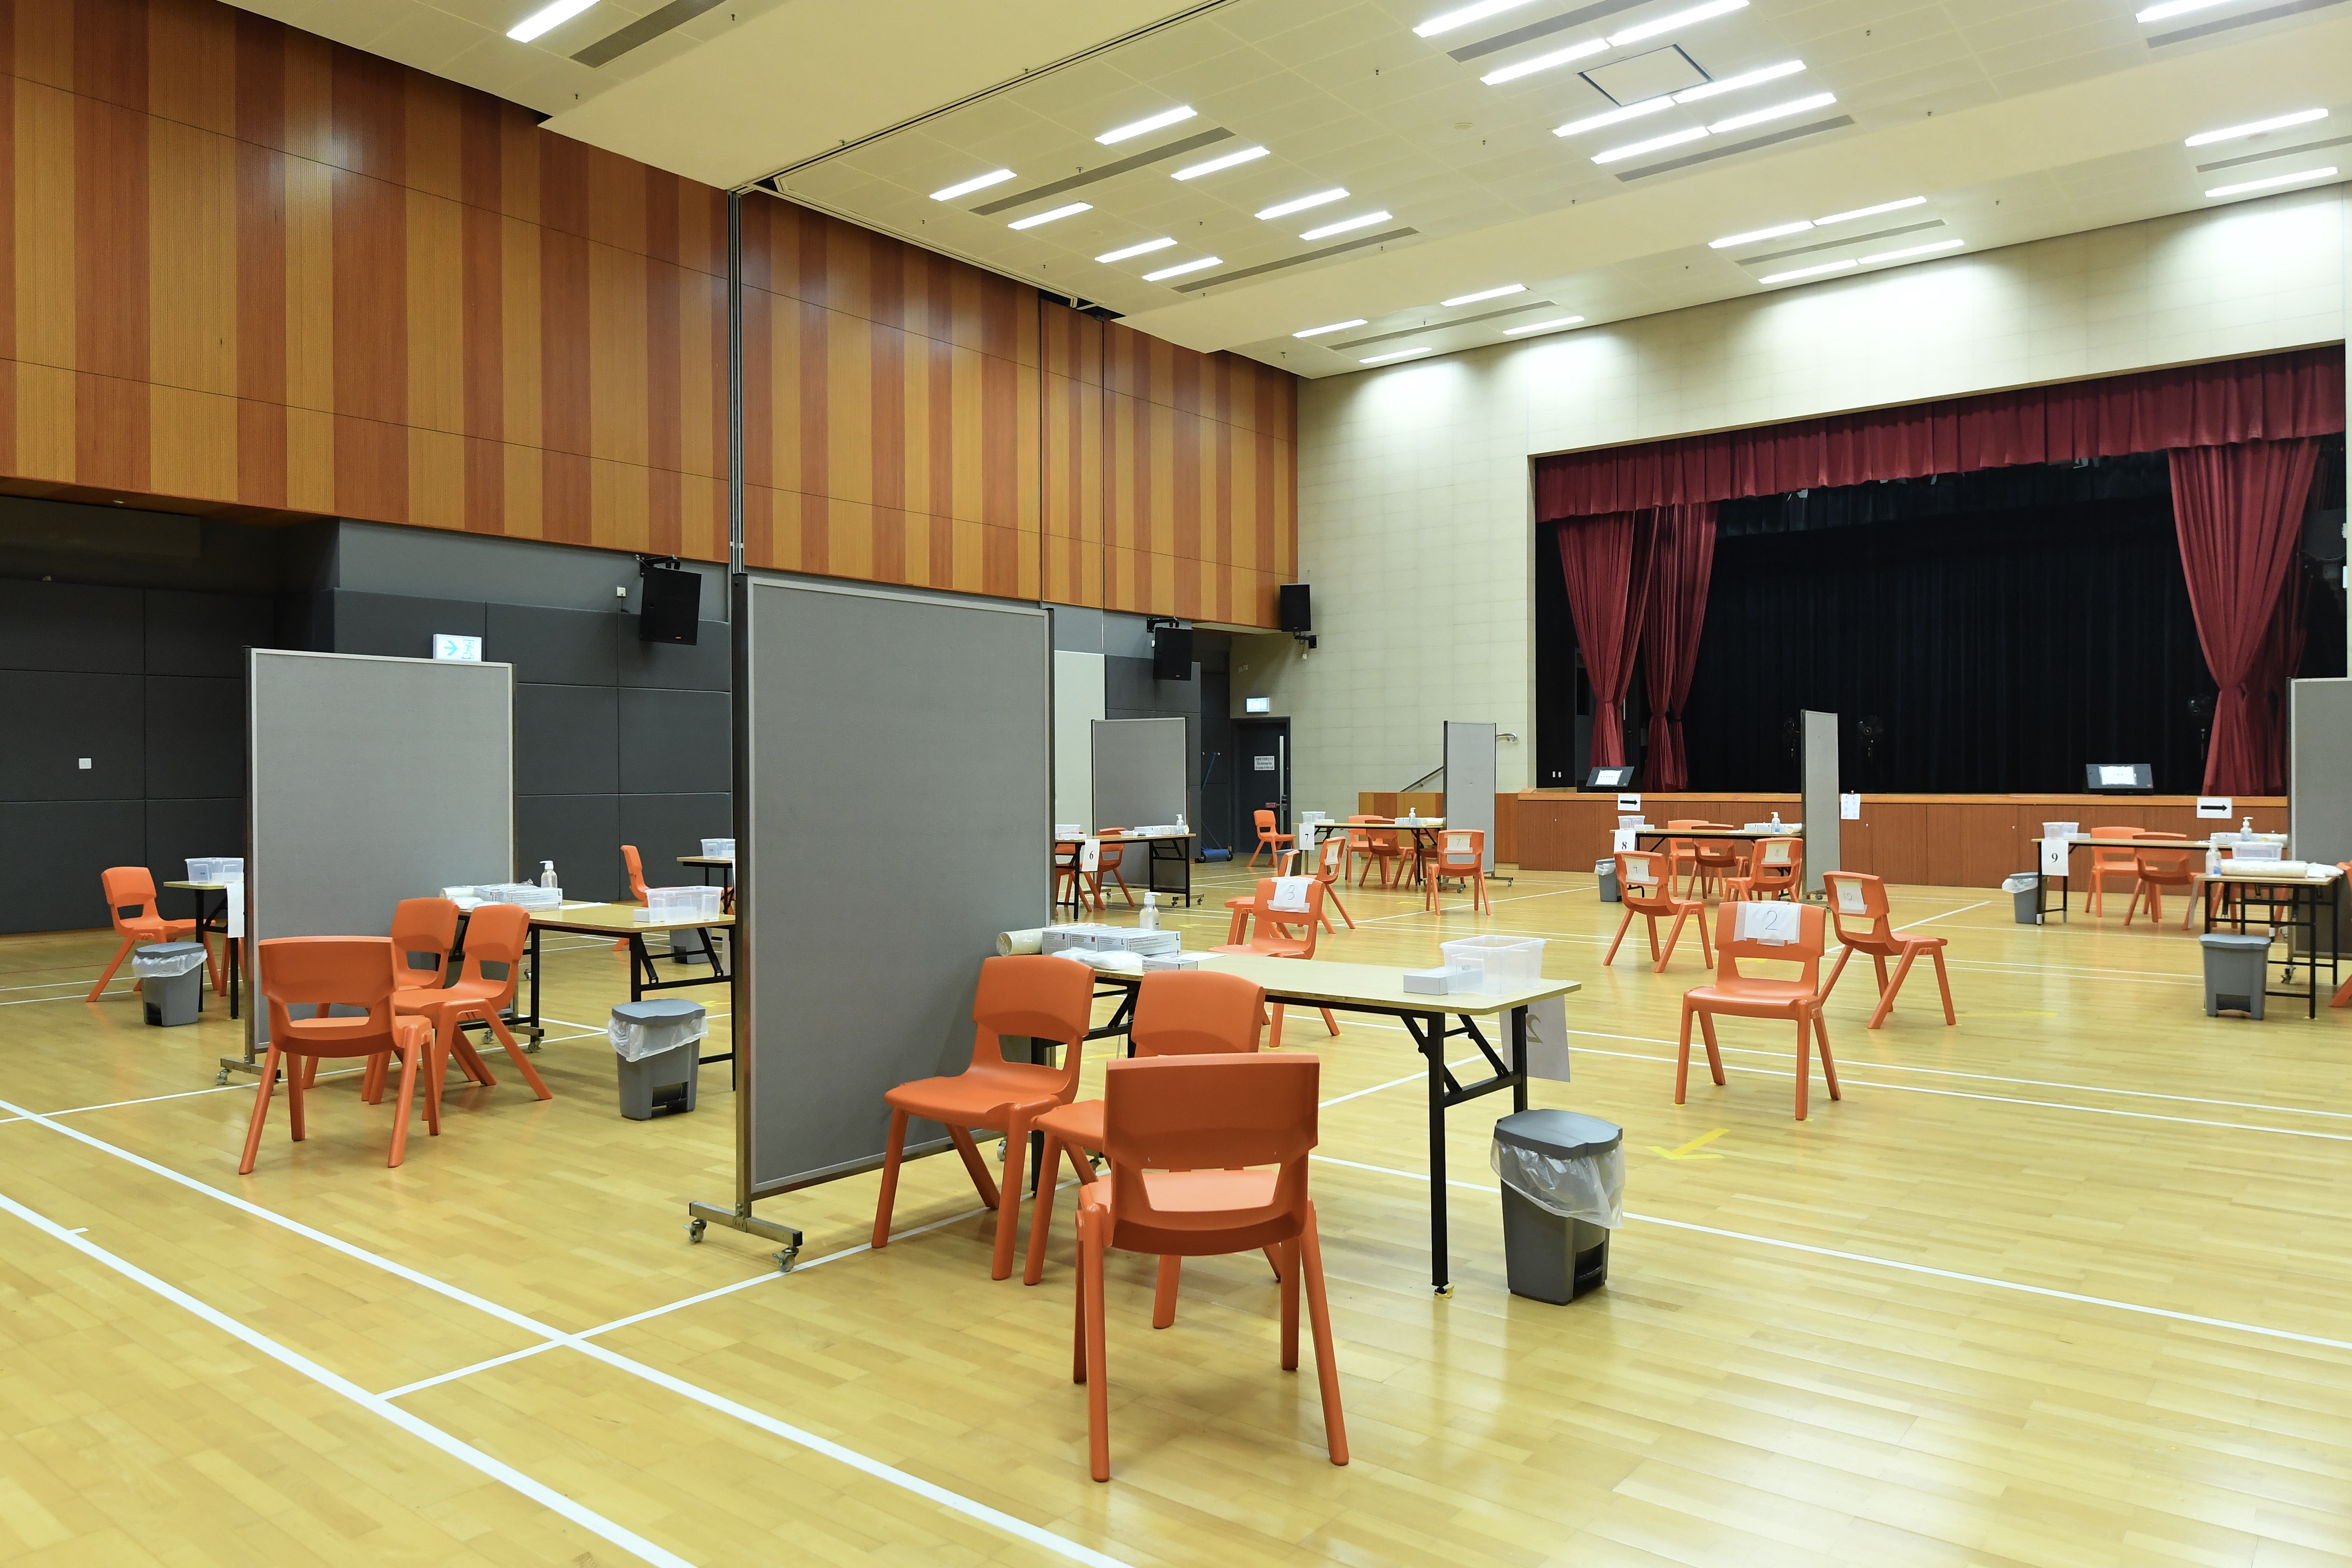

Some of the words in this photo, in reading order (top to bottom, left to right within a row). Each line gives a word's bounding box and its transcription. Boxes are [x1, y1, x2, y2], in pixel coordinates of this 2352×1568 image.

[1622, 841, 1627, 849] 8
[1089, 850, 1094, 860] 6
[1775, 849, 1780, 857] 8
[2051, 852, 2058, 863] 9
[1633, 865, 1638, 874] 9
[1288, 885, 1295, 900] 3
[1843, 892, 1852, 901] 10
[1765, 910, 1777, 930] 2
[1176, 933, 1179, 941] L
